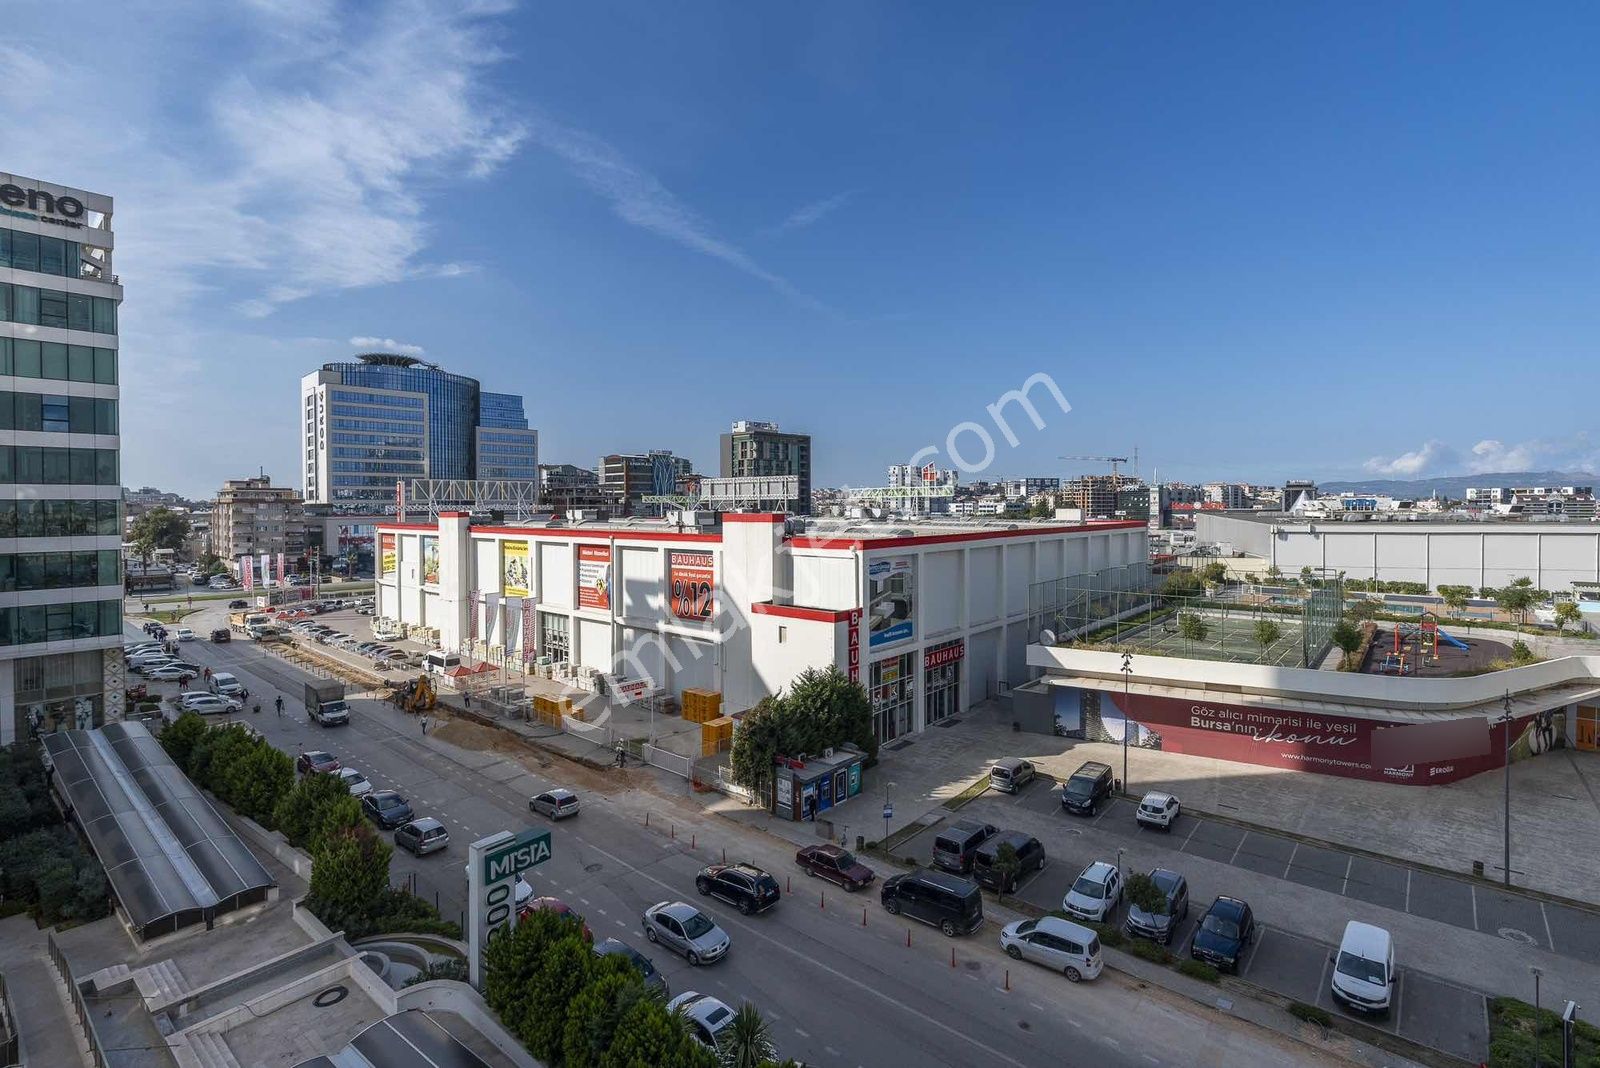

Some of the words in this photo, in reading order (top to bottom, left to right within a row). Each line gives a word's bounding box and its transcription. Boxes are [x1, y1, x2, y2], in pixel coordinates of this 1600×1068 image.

[671, 554, 713, 566] BAUHAUS
[673, 579, 713, 619] %12
[850, 612, 859, 681] BAUH
[924, 645, 964, 668] BAUHAUS
[1191, 705, 1215, 718] Göz
[1218, 709, 1243, 721] alıcı
[1247, 713, 1302, 728] mimarisi
[1306, 718, 1322, 729] ile
[1326, 722, 1357, 735] yeşil
[1253, 723, 1357, 746] ikonu
[1280, 752, 1372, 769] www.harmonytowers.co
[490, 840, 551, 881] MISTA
